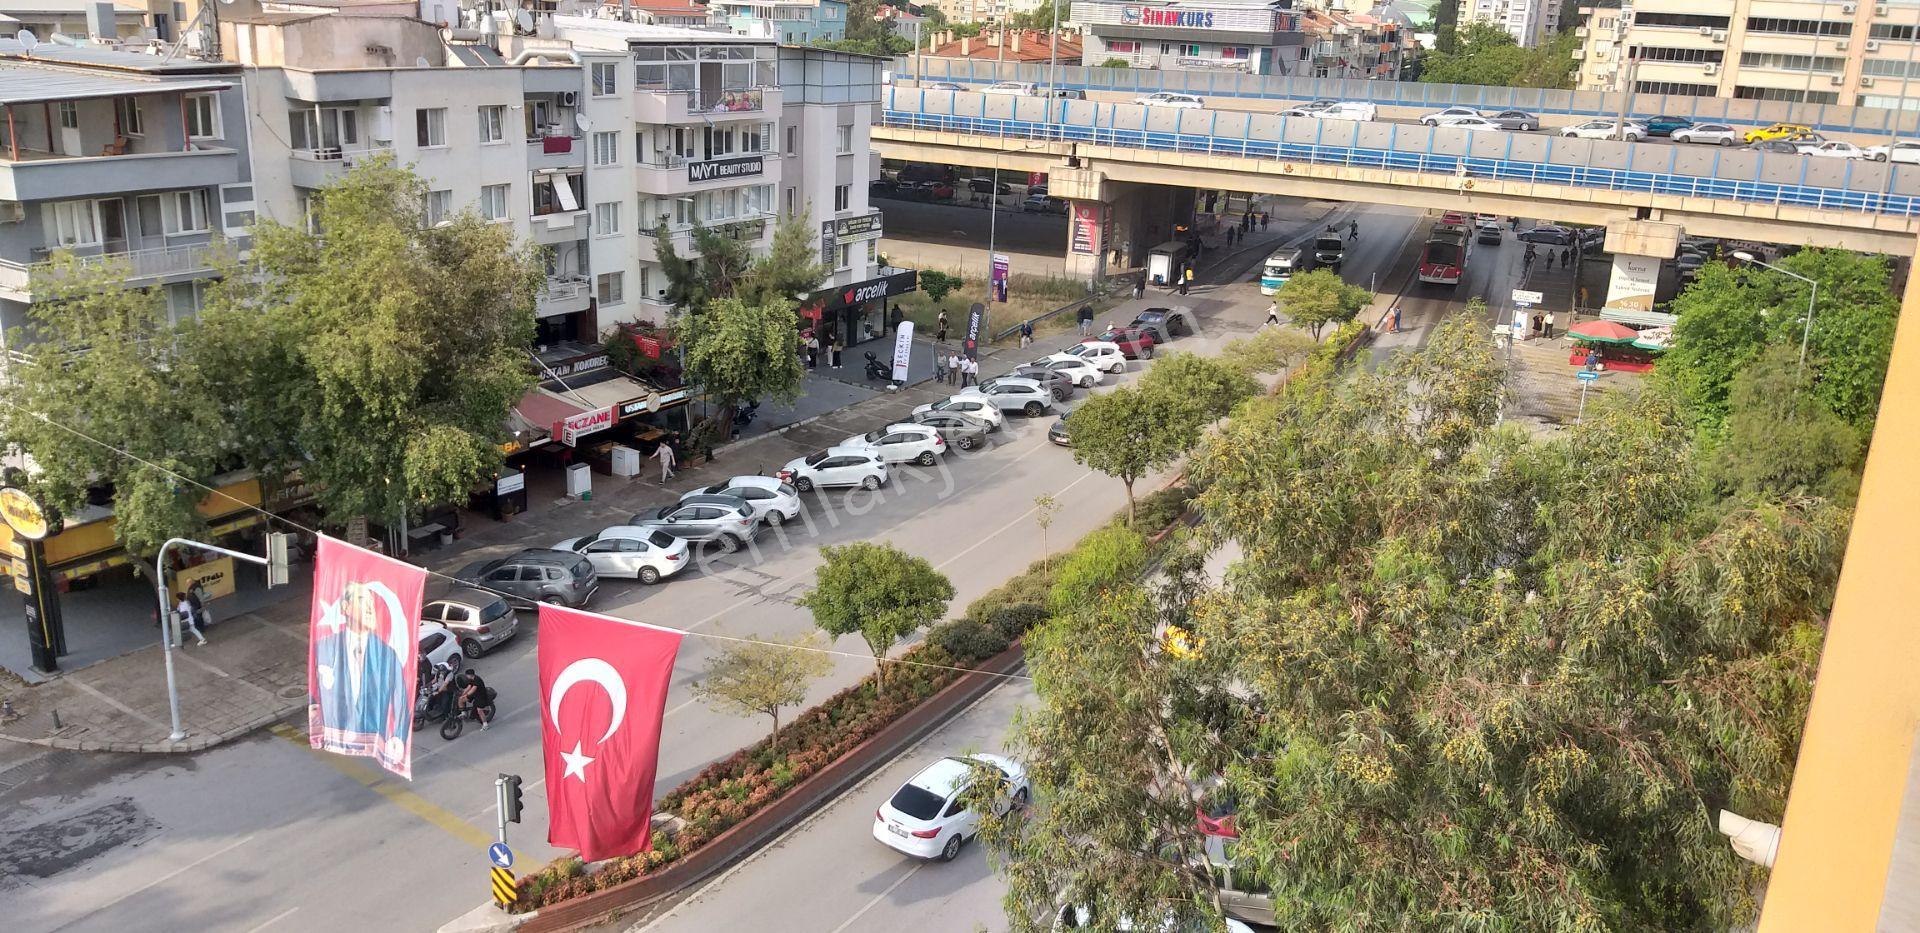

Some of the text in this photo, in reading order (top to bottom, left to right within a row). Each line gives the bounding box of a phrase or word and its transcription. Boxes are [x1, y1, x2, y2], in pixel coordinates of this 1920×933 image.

[720, 165, 740, 175] BEAUTY
[741, 161, 761, 173] STUDIO
[855, 280, 888, 302] arçelik
[969, 312, 980, 340] arçelik
